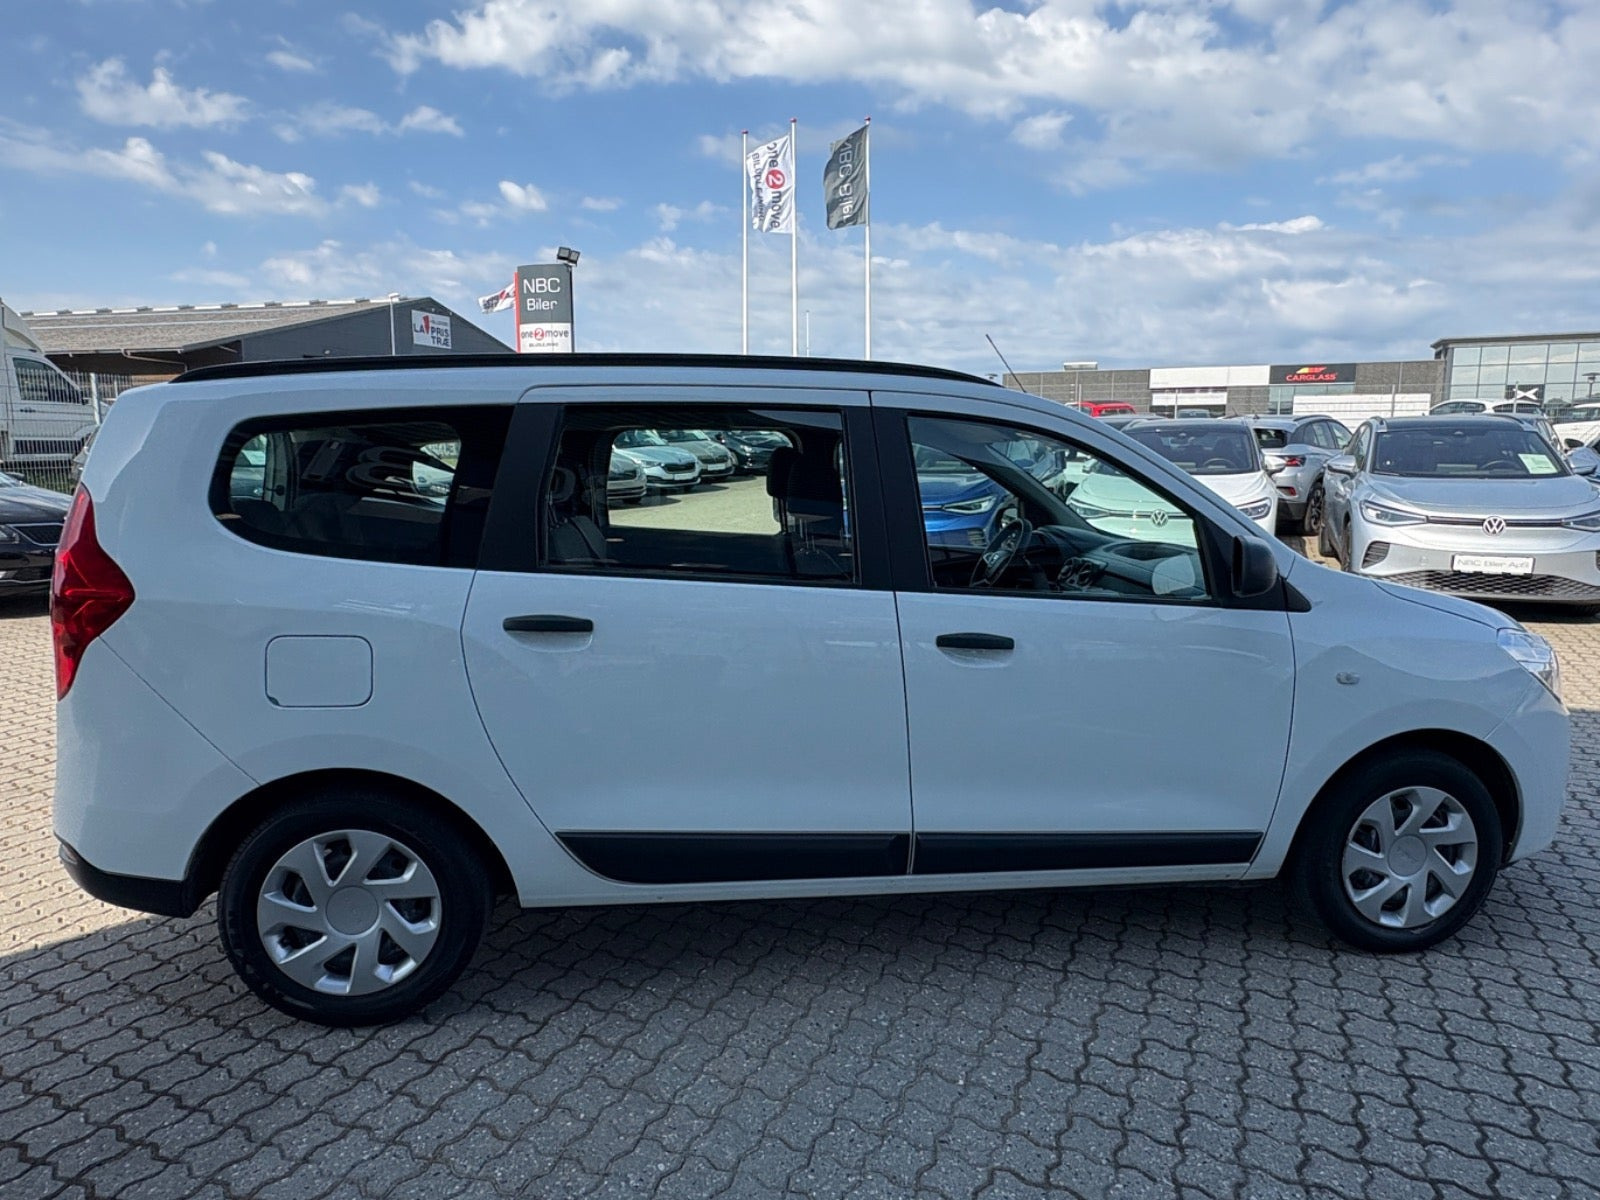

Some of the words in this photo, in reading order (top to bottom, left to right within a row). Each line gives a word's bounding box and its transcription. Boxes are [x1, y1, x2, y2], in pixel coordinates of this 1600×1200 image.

[523, 277, 561, 294] NBC
[526, 298, 558, 311] Biler
[520, 327, 570, 341] one2move
[1285, 373, 1336, 381] CARGLASS
